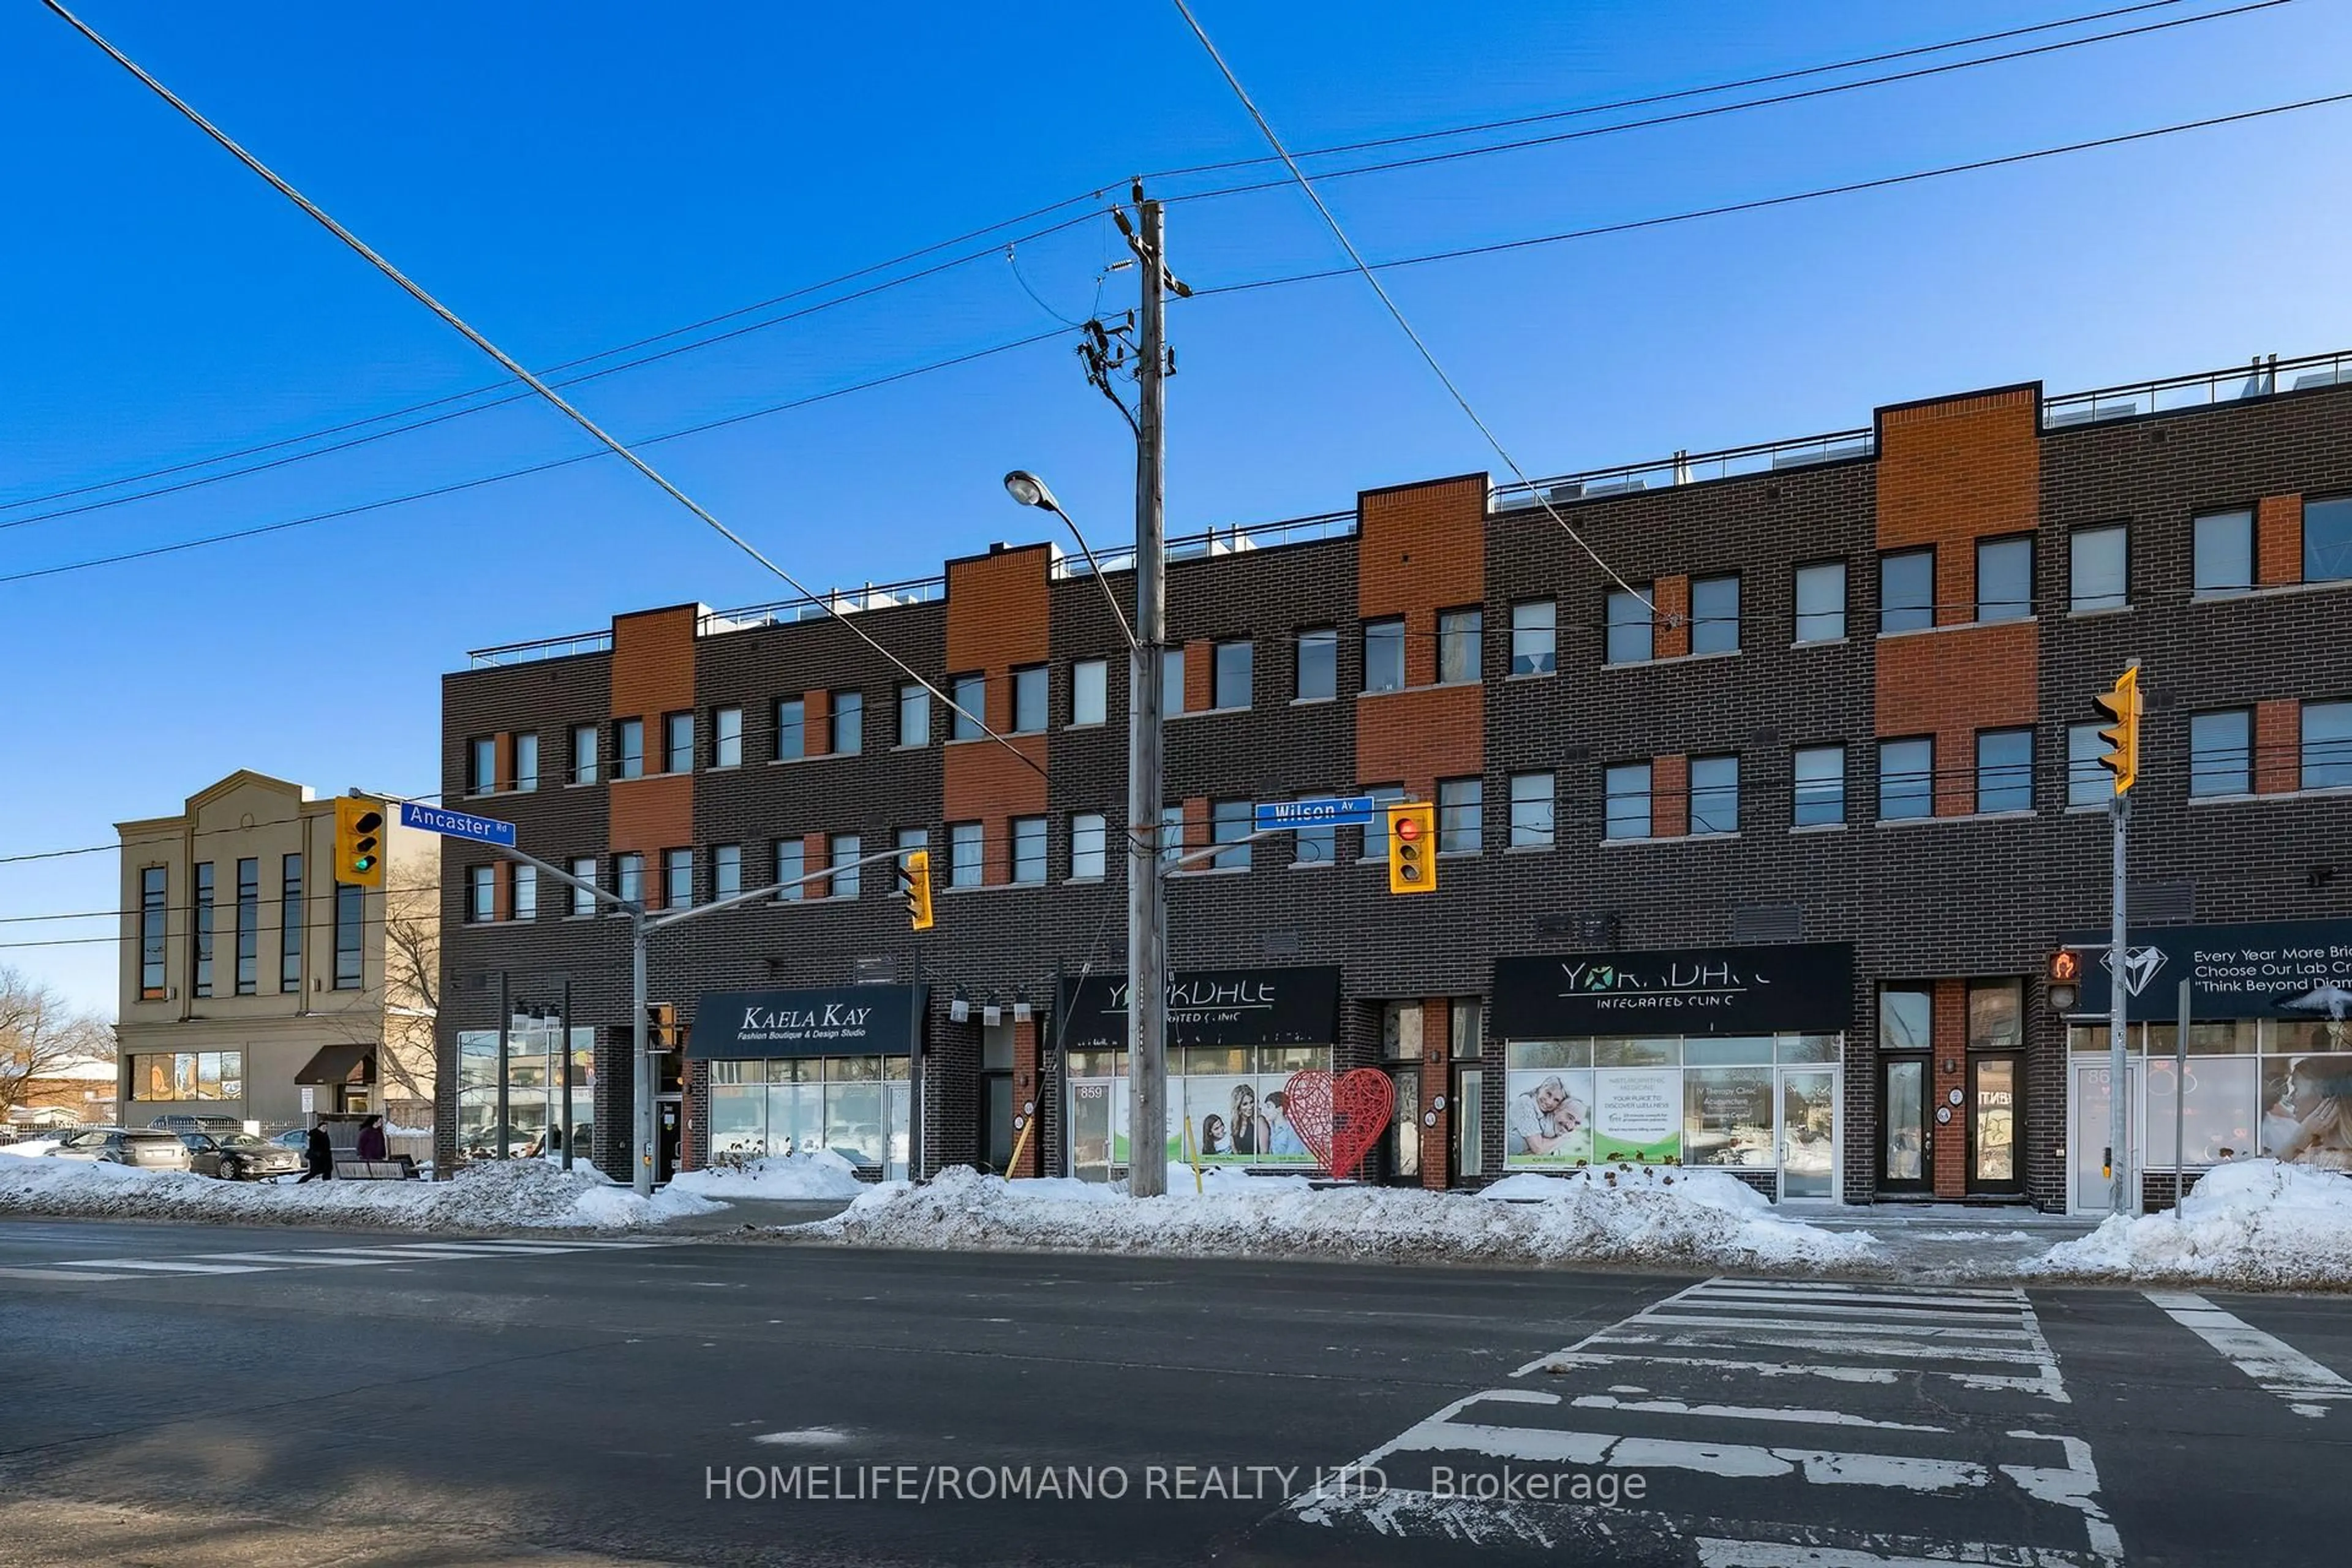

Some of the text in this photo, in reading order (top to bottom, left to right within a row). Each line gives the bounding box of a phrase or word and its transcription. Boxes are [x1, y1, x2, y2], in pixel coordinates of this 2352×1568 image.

[410, 806, 507, 835] Ancaster Rd
[1275, 804, 1335, 822] Wilson
[2194, 951, 2236, 963] Every
[2241, 949, 2277, 961] Year
[2282, 948, 2325, 959] More
[2195, 965, 2257, 978] Choose
[2261, 963, 2292, 976] Our
[2296, 962, 2328, 974] Lab
[2246, 978, 2309, 993] Beyond
[1687, 995, 1734, 1006] CLINC
[741, 1003, 873, 1029] KAELA KAY
[737, 1028, 866, 1040] Fashion Boutique & Design Studio
[2088, 1069, 2110, 1084] 86
[1080, 1087, 1102, 1099] 859
